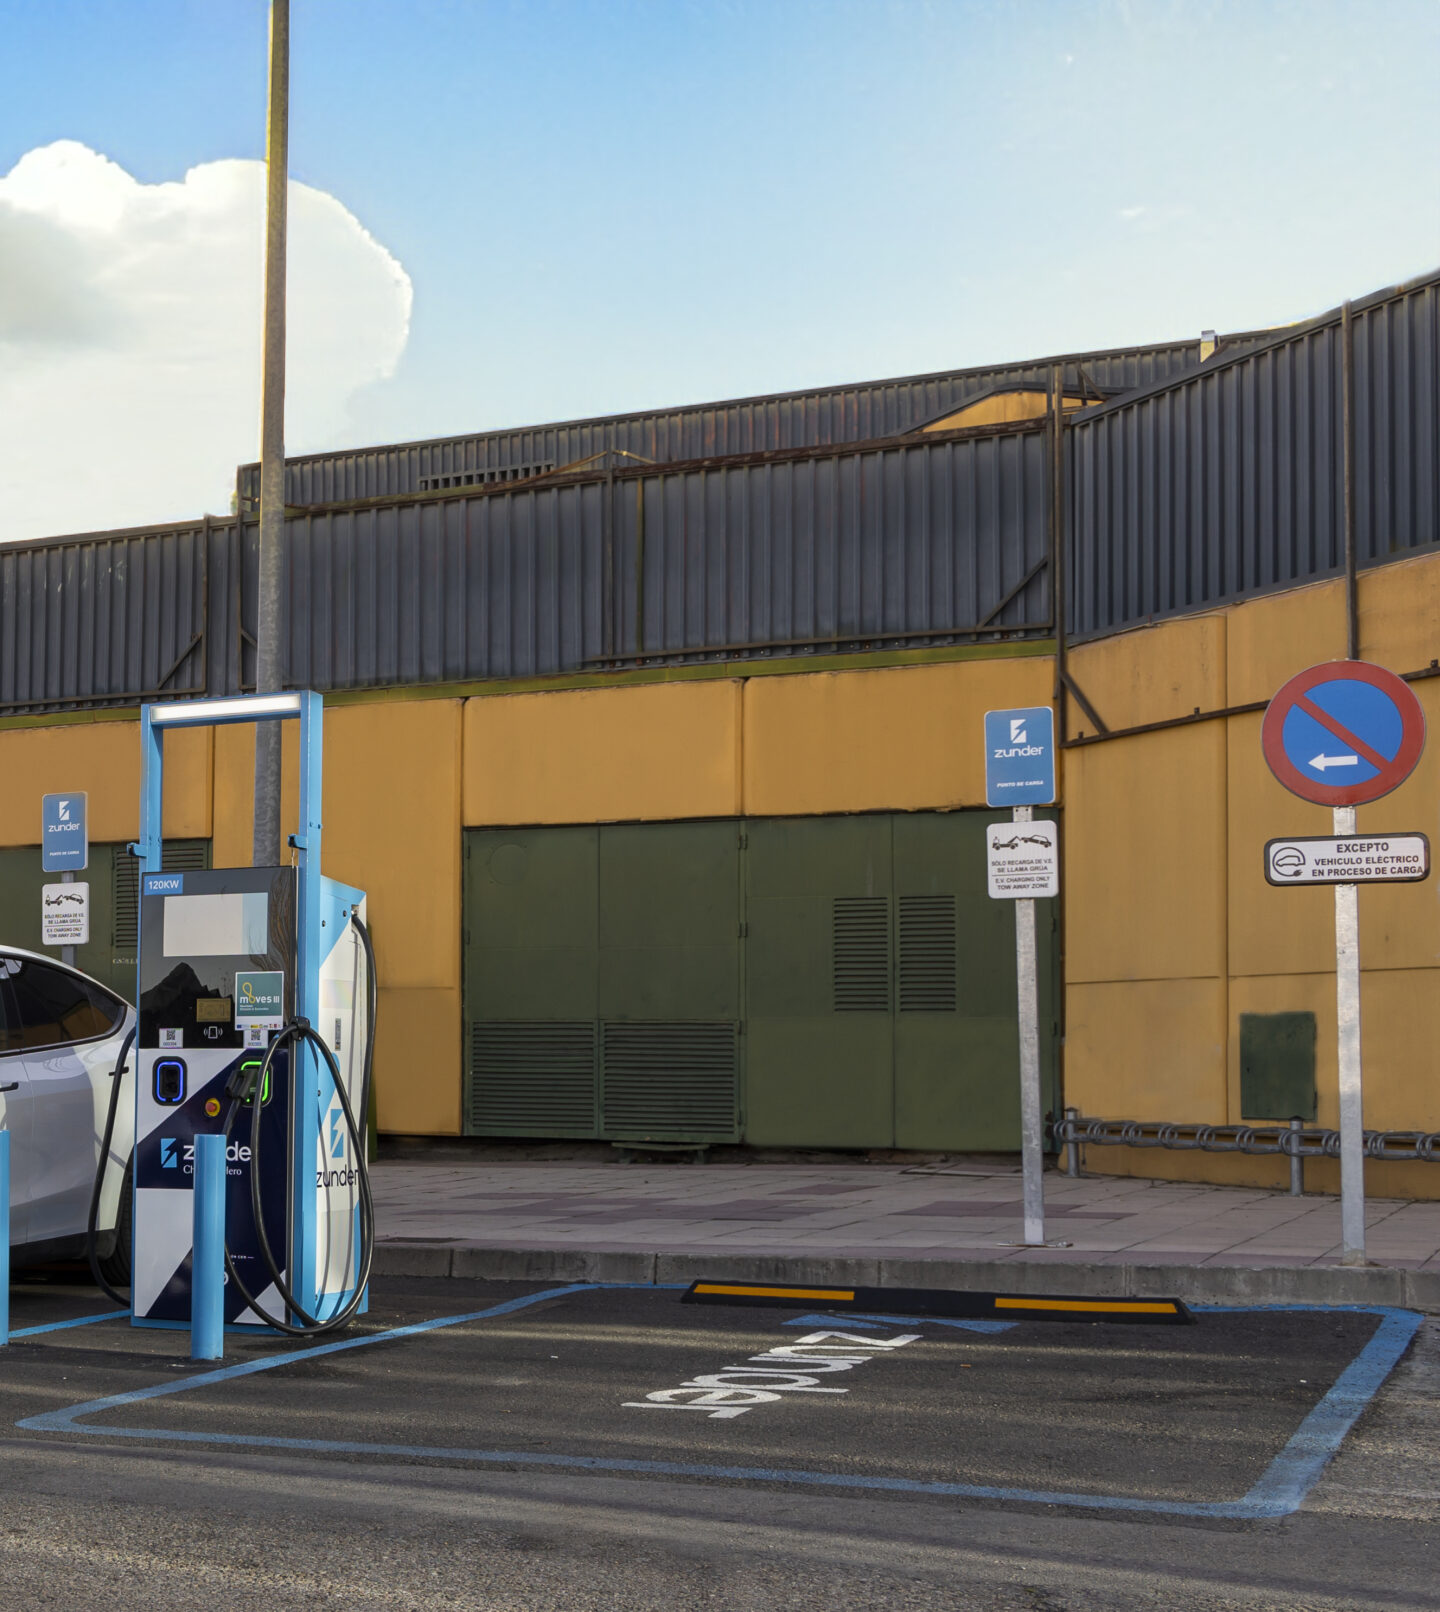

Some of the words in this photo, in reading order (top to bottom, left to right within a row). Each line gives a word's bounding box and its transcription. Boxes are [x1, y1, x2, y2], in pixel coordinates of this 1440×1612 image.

[994, 745, 1044, 758] zunder
[48, 822, 80, 832] zunder
[1336, 842, 1389, 853] EXCEPTO
[1312, 869, 1324, 877] EN
[1327, 868, 1372, 876] PROCESO
[1375, 867, 1387, 875] DE
[1390, 866, 1424, 875] CARGA
[148, 880, 180, 890] 120KW
[316, 1163, 359, 1188] zunder
